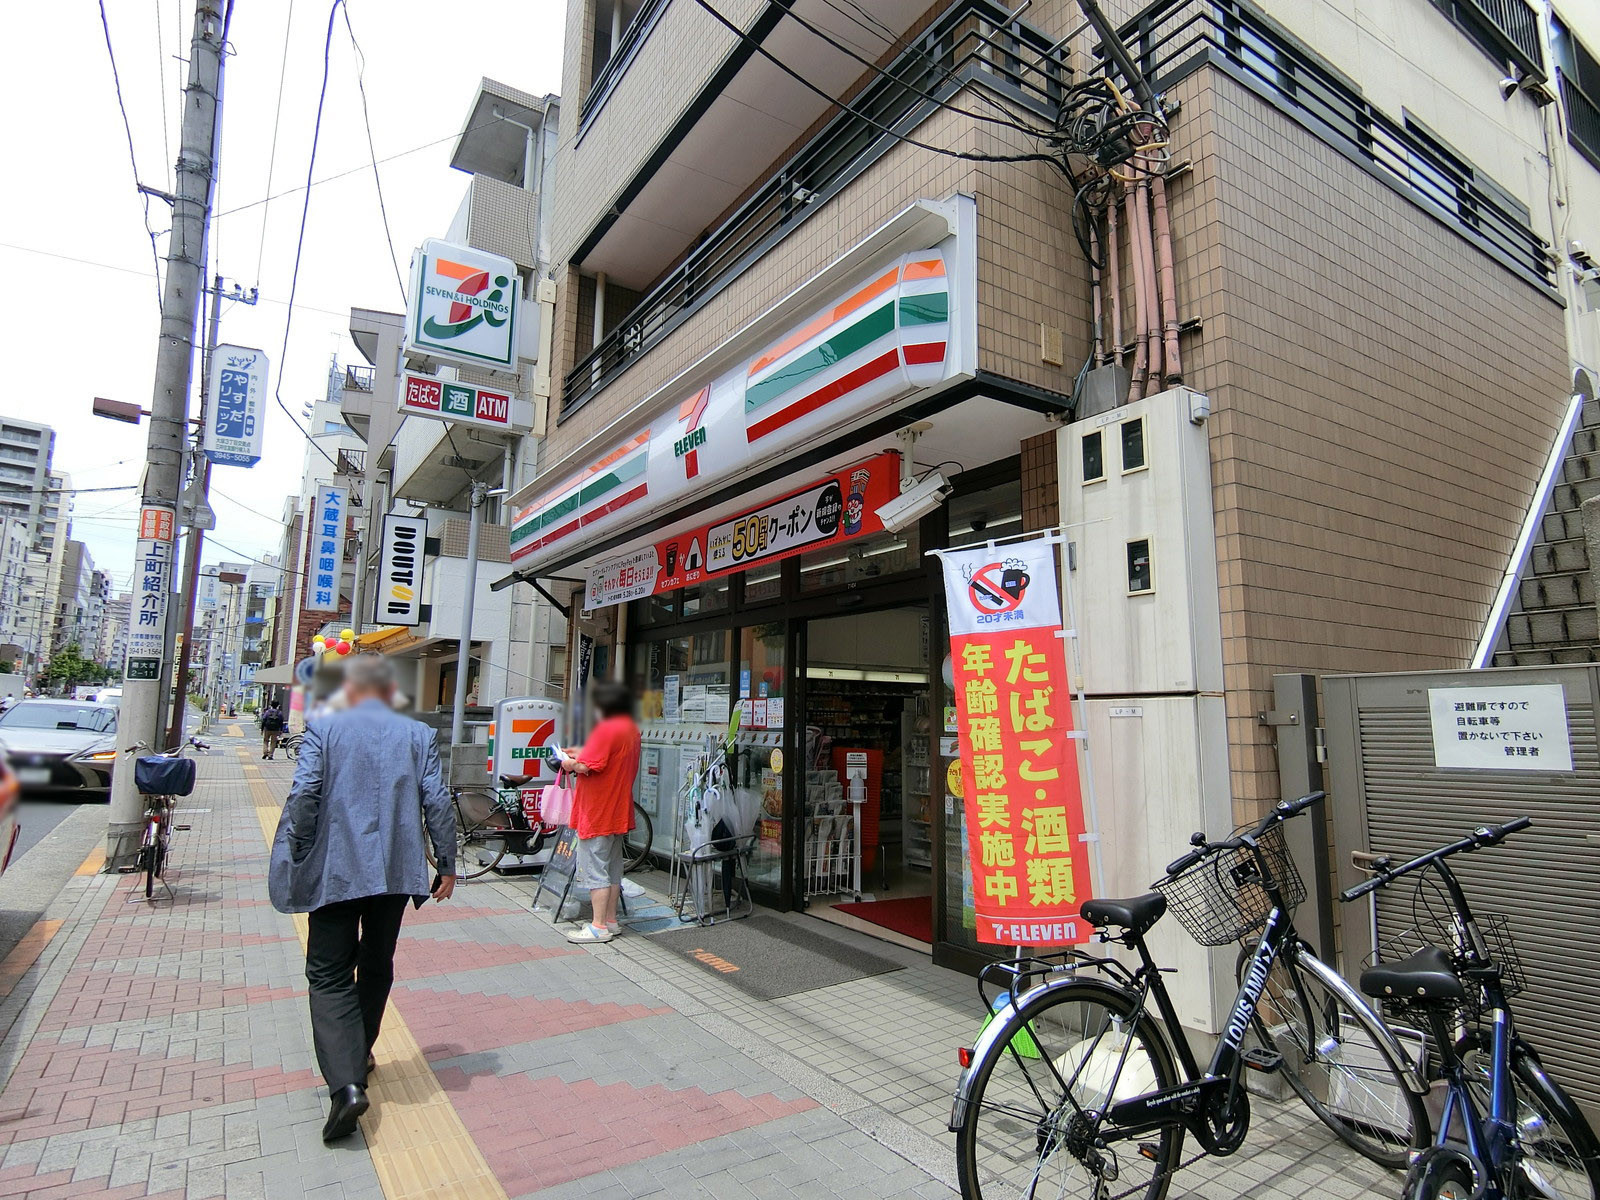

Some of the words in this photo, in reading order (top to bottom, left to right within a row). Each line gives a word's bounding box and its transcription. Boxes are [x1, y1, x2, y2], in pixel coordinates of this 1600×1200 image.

[465, 296, 509, 314] HOLDINGS
[216, 372, 234, 433] クリニック
[230, 374, 248, 422] やすだ
[407, 382, 440, 406] たばこ
[448, 390, 470, 412] 酒
[478, 396, 508, 419] ATM
[673, 426, 706, 458] ELEVEN
[214, 452, 250, 463] 3945-5055
[315, 491, 342, 606] 大蔵耳鼻咽喉科
[387, 526, 417, 616] DOUTOR
[138, 541, 164, 627] 上町紹介所
[976, 609, 1025, 624] 20才未満
[130, 669, 154, 677] 2-11
[1454, 701, 1529, 712] 避難扉ですので
[1456, 716, 1501, 726] 自転車等
[1457, 731, 1543, 741] 置かないで下さい
[1504, 745, 1540, 757] 管理者
[962, 642, 1019, 906] 年齢確認実施中
[1004, 639, 1077, 906] たばこ・酒類
[991, 921, 1078, 941] 7-ELEVEN
[1223, 999, 1254, 1051] LOUIS
